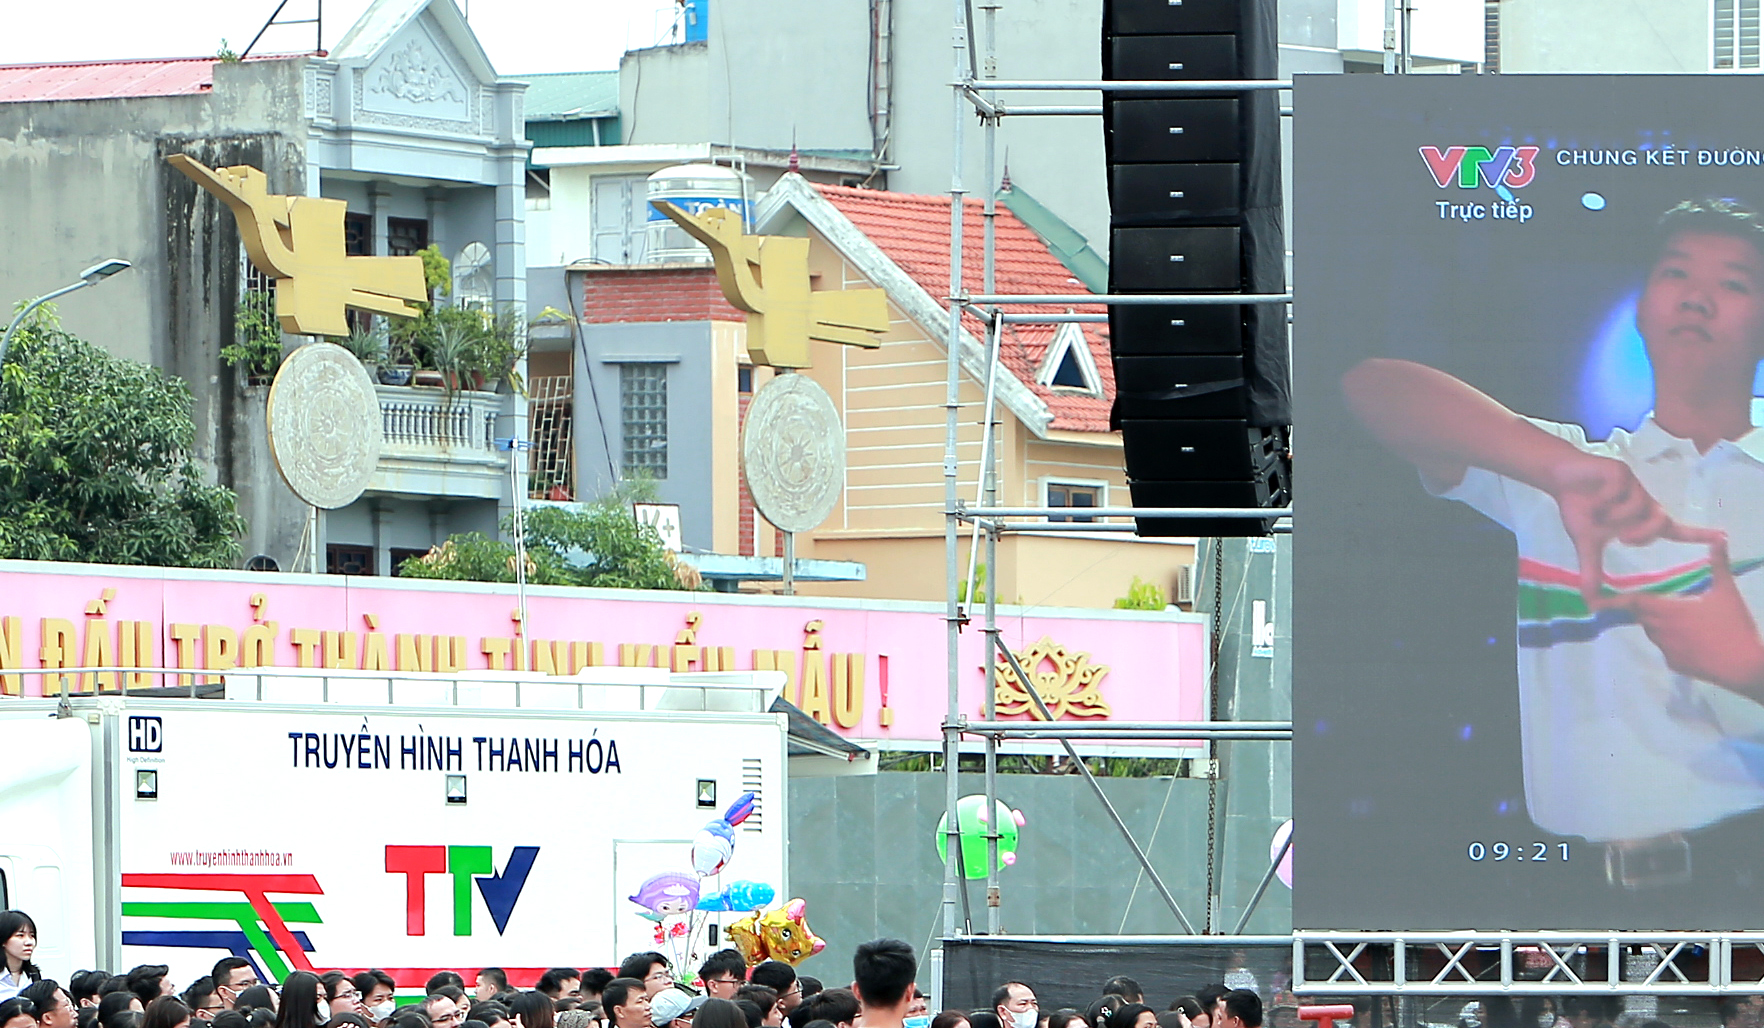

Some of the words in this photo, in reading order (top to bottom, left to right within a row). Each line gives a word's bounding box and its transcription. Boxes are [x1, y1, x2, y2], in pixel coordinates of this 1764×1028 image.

[1418, 146, 1540, 188] VTV3
[1556, 149, 1637, 166] CHUNG
[1646, 143, 1690, 166] KẾT
[1435, 201, 1486, 222] Trực
[1491, 198, 1534, 223] tiếp
[39, 587, 153, 697] ĐẤU
[130, 718, 162, 750] HD
[288, 716, 390, 770] TRUYỀN
[401, 724, 463, 771] HÌNH
[472, 736, 559, 773] THANH
[568, 728, 622, 775] HÓA
[1468, 841, 1571, 862] 09:21
[385, 845, 541, 937] TTV
